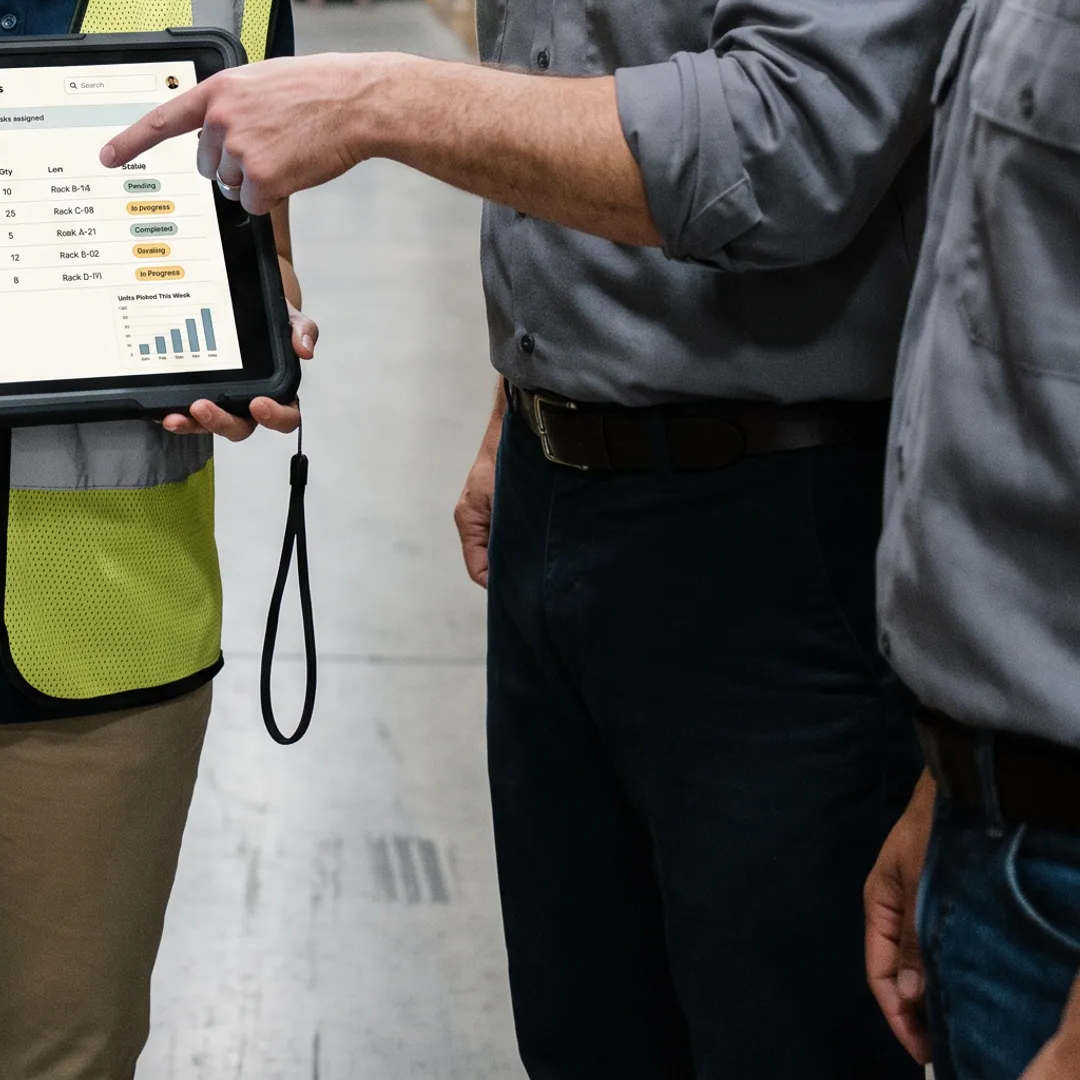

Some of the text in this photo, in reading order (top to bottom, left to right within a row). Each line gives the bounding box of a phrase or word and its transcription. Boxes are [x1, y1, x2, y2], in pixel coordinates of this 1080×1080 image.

[13, 114, 45, 123] assigned
[2, 188, 12, 196] 10
[5, 210, 16, 218] 25
[11, 254, 20, 262] 12
[13, 276, 19, 284] 8
